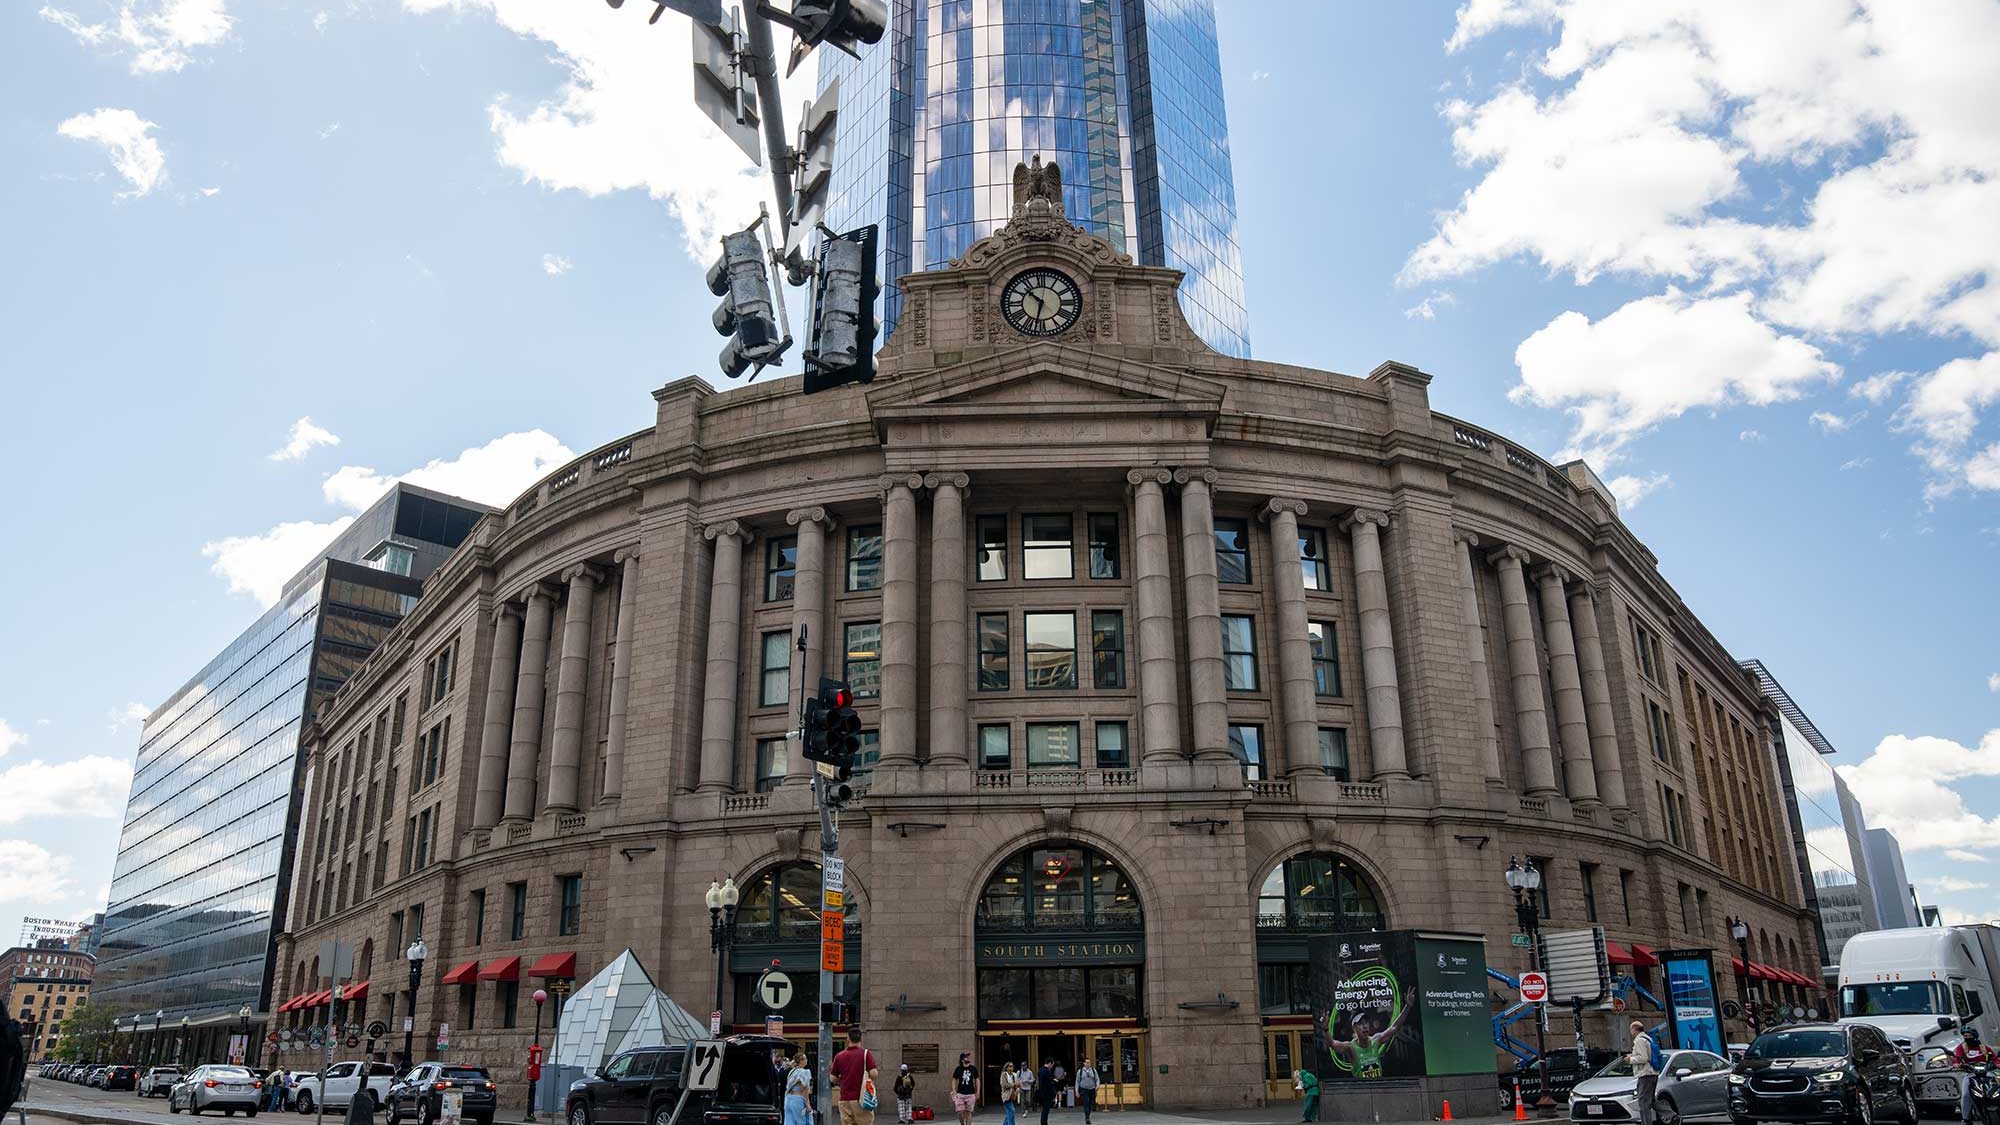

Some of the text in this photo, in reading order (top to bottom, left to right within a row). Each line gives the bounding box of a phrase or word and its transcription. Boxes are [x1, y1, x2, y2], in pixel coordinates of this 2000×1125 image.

[833, 862, 843, 871] NOT
[826, 871, 841, 881] BLOCK
[23, 916, 51, 925] BOSTON
[54, 919, 77, 927] WHARF
[33, 925, 74, 935] INDUSTRIAL
[983, 943, 1135, 957] SOUTH STATION
[1337, 977, 1387, 989] Advancing
[766, 981, 788, 1004] T
[1335, 986, 1393, 1001] Energy Tech
[1425, 990, 1485, 999] Advancing Energy Tech
[1335, 998, 1392, 1011] to go further
[1550, 1074, 1574, 1082] POLICE
